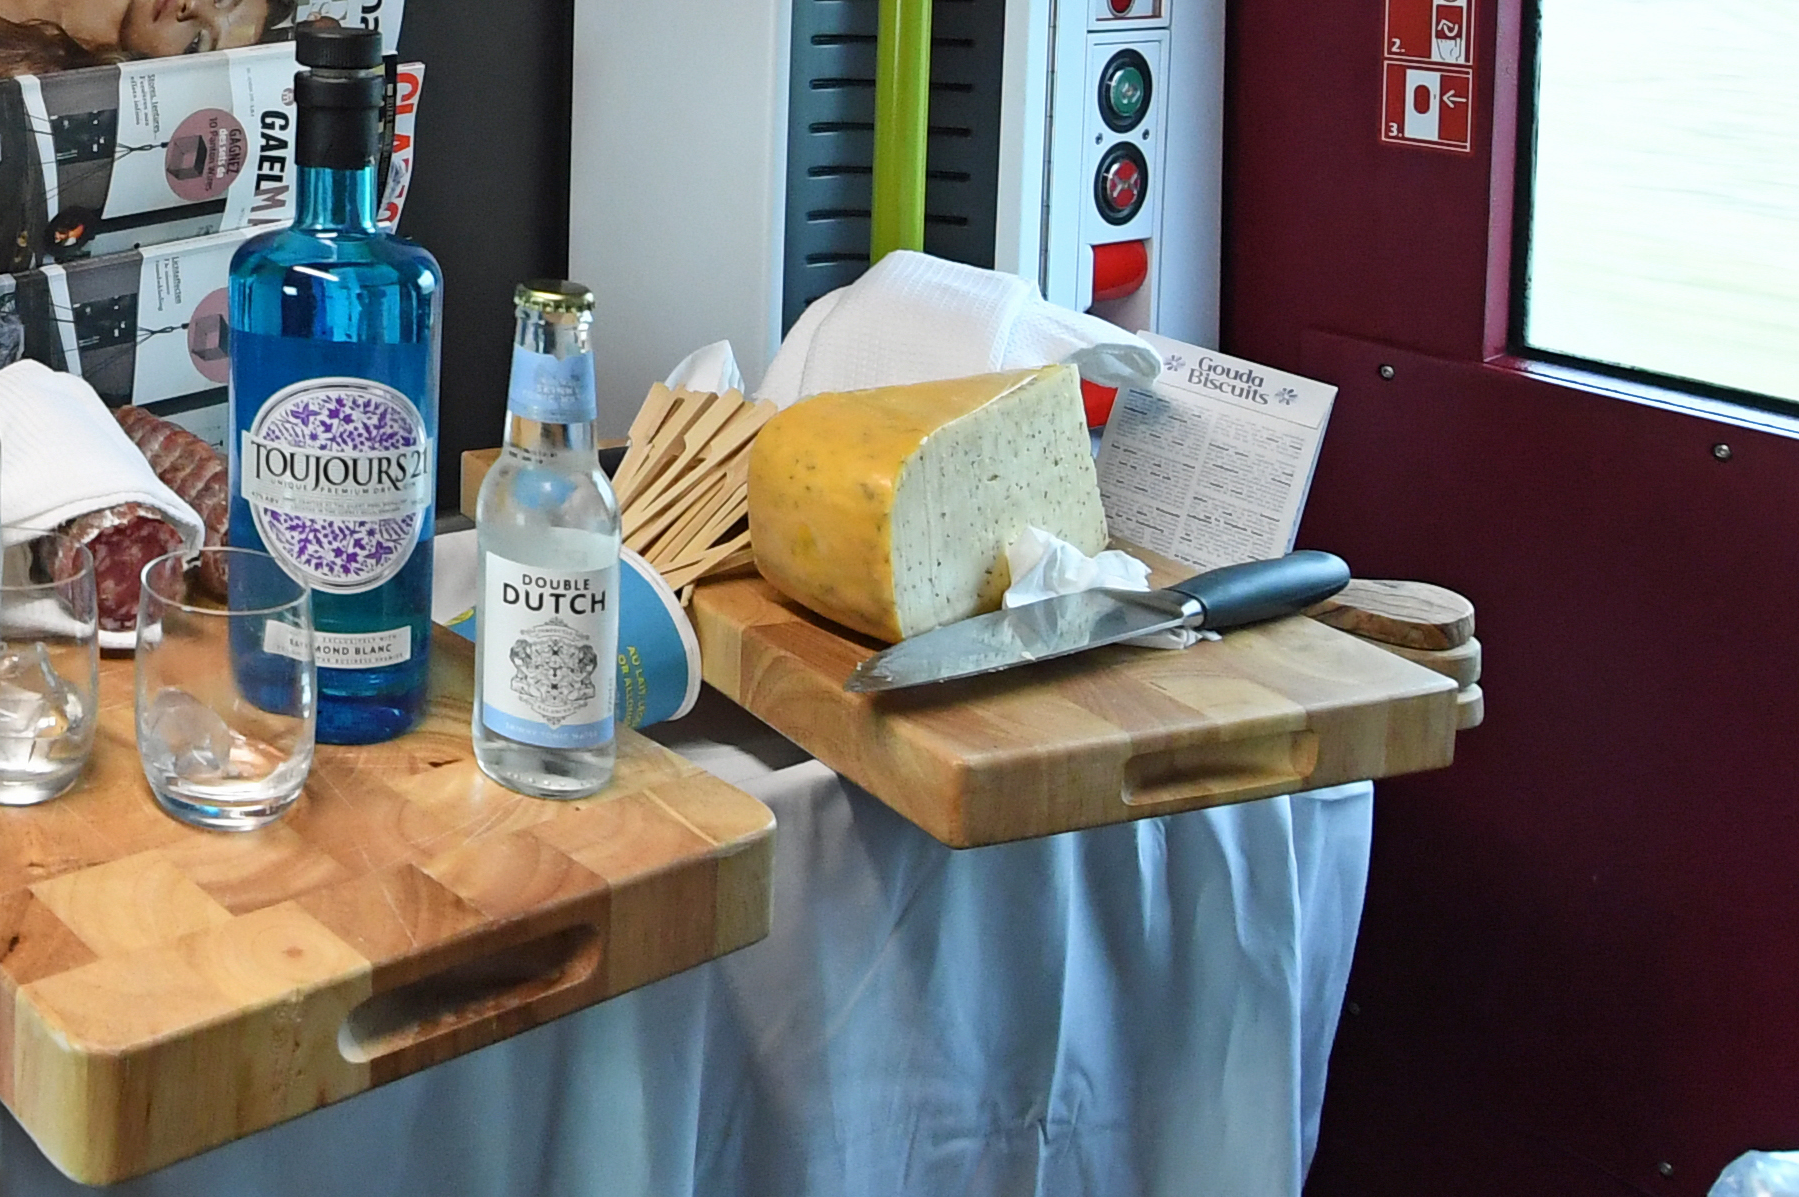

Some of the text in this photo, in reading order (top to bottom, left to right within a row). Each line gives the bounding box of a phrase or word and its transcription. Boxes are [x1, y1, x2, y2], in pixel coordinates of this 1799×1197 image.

[1391, 39, 1405, 53] 2.
[1388, 122, 1403, 137] 3.
[226, 128, 241, 175] GAGNEZ
[1198, 356, 1265, 388] Gouda
[1187, 367, 1270, 406] Biscuits
[251, 440, 429, 492] TOUJOURS 21
[270, 478, 392, 495] UNIQUE PREMIUM DRY
[522, 573, 590, 591] DOUBLE
[503, 582, 606, 615] DUTCH
[322, 636, 377, 644] EXCLUSIVELY
[354, 643, 393, 655] BLANC
